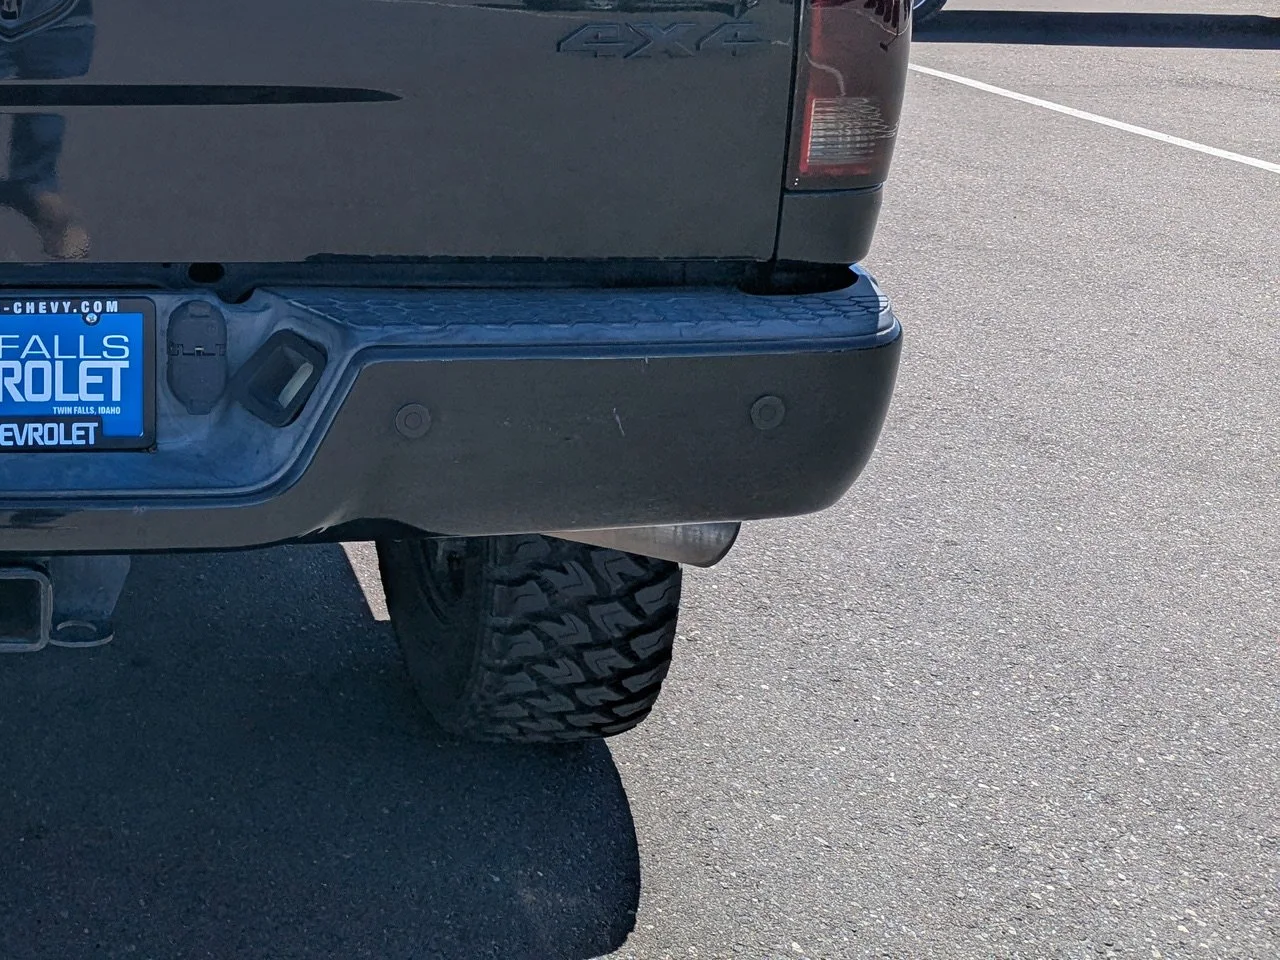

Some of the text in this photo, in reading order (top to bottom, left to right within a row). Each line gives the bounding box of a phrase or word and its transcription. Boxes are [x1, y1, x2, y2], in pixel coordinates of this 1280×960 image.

[53, 406, 121, 416] TWIN FALLS, IDAHO
